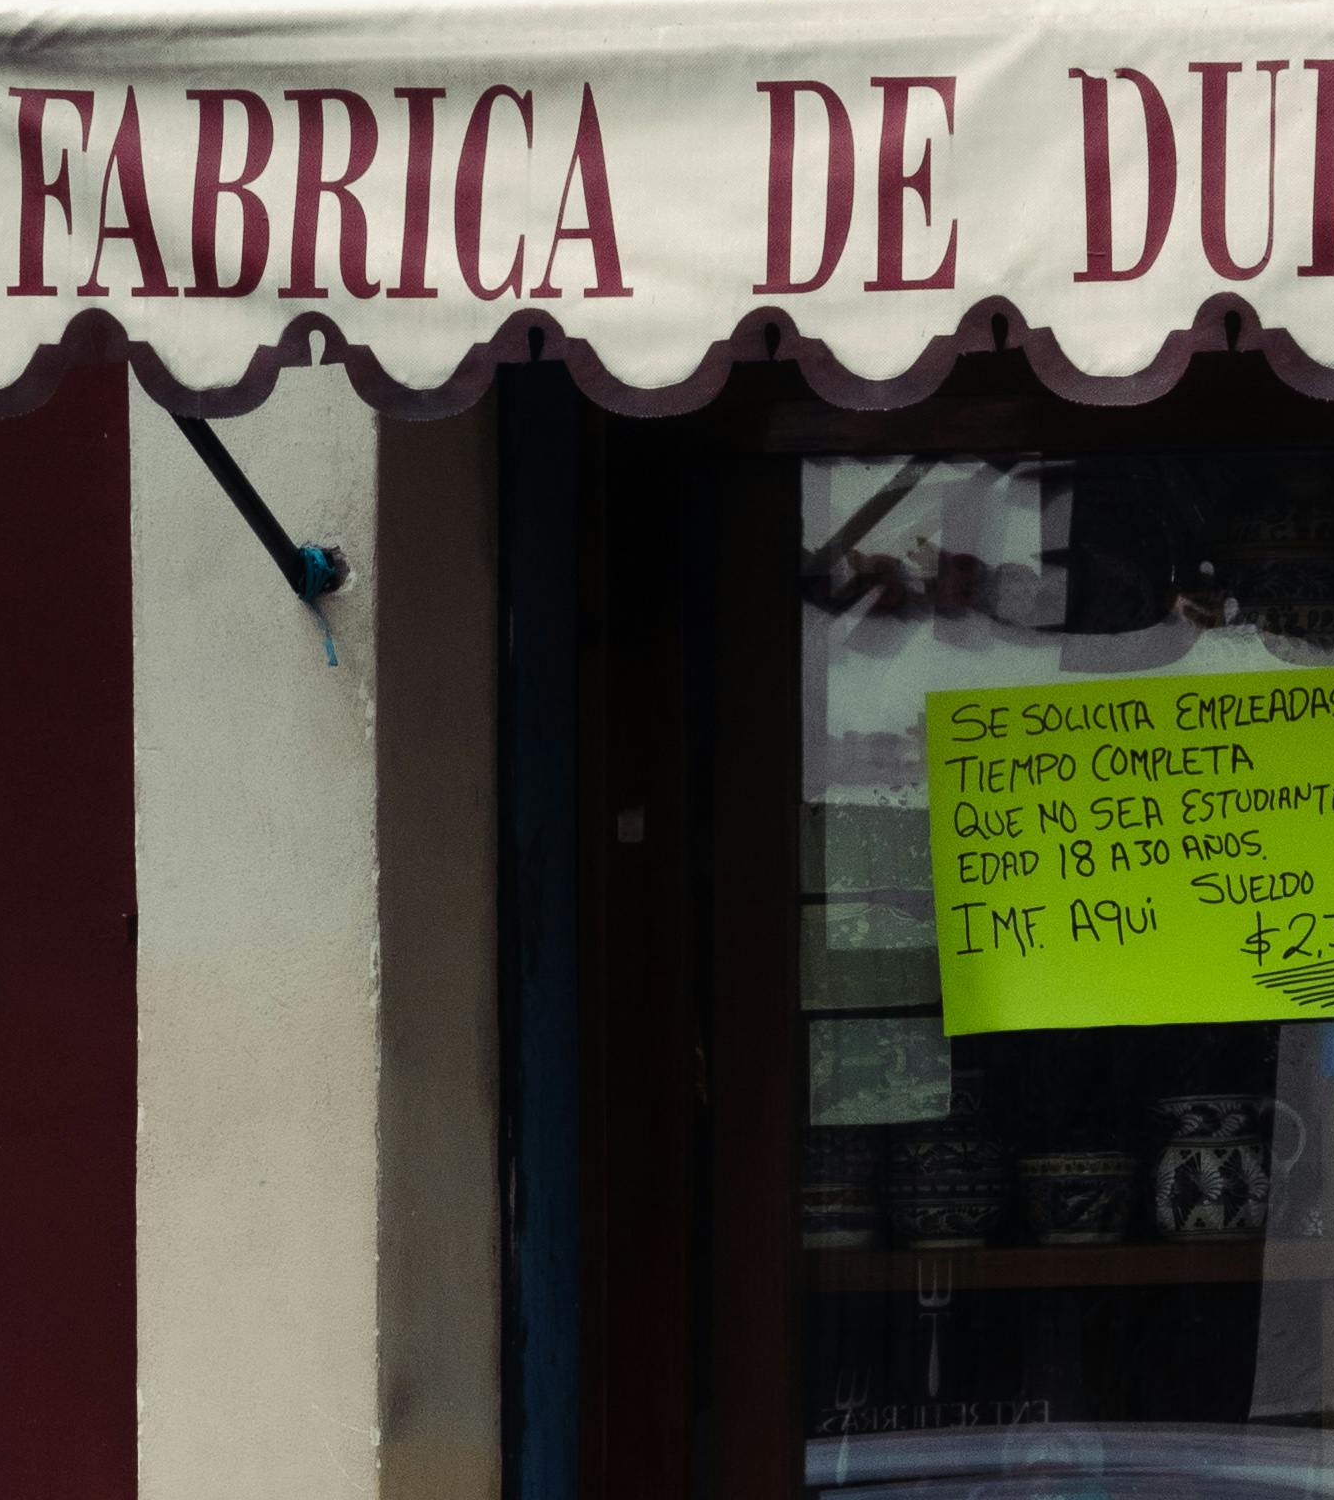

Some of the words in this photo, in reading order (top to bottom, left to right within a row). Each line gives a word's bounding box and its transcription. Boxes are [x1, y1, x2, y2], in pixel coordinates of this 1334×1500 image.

[6, 82, 634, 300] FABRICA
[752, 75, 958, 296] DE
[952, 703, 1009, 742] SE
[1022, 699, 1155, 736] SOLICITA
[945, 752, 1076, 794] TIEMPO
[1091, 743, 1254, 782] COMPLETA
[954, 802, 1024, 841] QUE
[1039, 799, 1077, 835] NO
[1091, 795, 1164, 832] SEA
[958, 850, 1039, 885] EDAD
[1059, 840, 1095, 879] 18
[1134, 838, 1170, 867] 30
[1190, 871, 1314, 905] SUELDO
